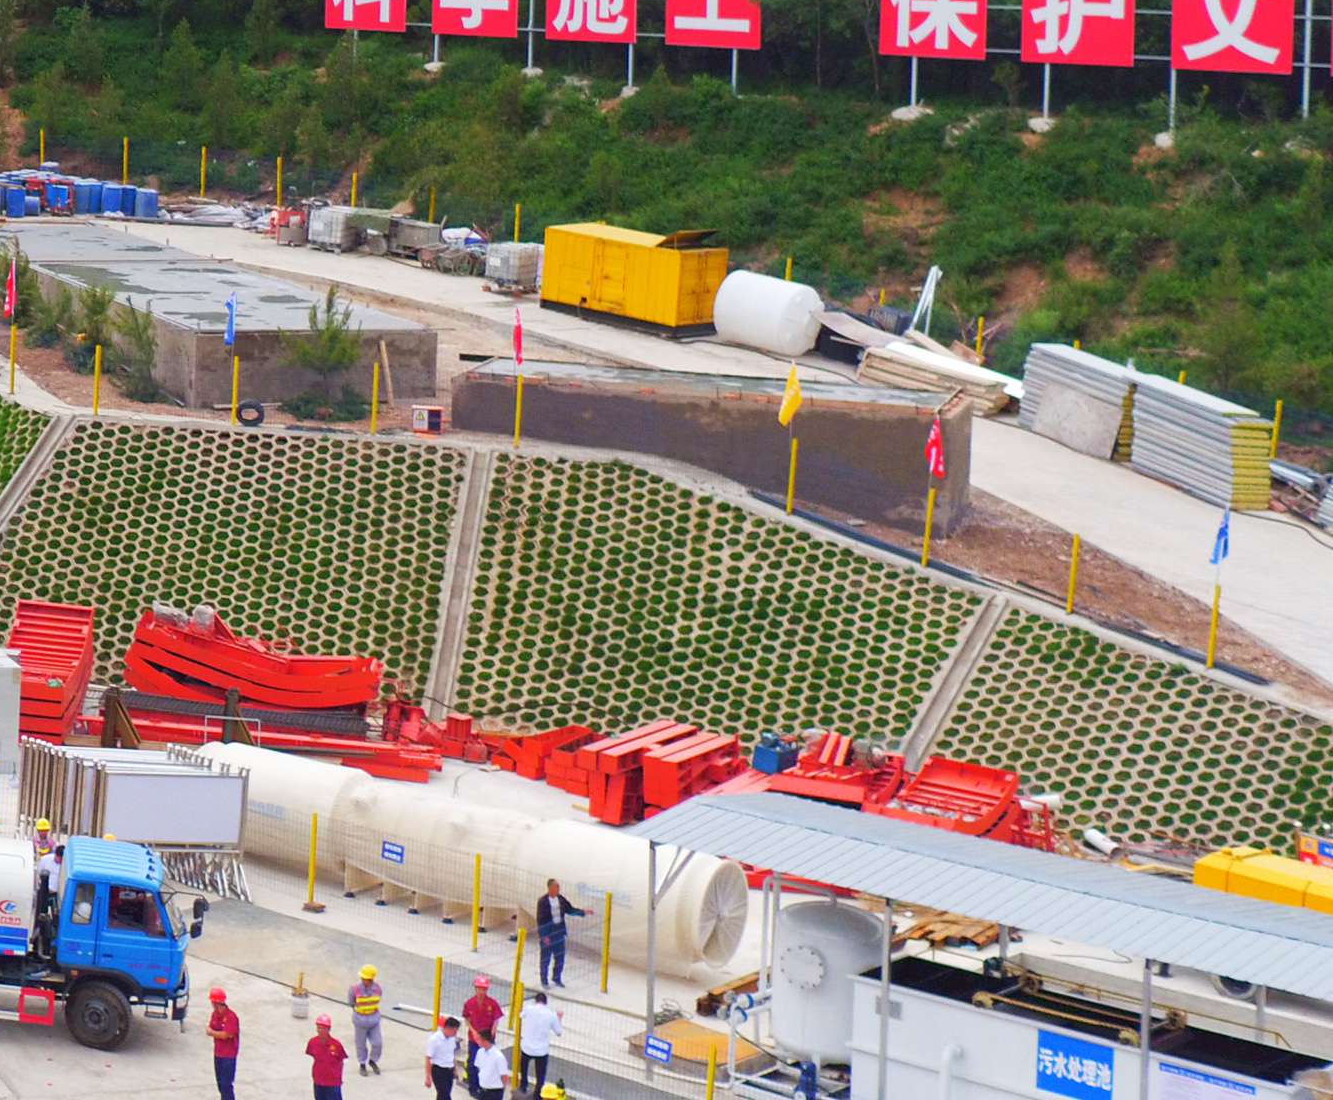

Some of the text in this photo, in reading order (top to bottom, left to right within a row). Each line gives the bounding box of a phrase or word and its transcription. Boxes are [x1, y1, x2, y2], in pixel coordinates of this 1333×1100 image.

[1038, 1046, 1112, 1092] 污水处理池
